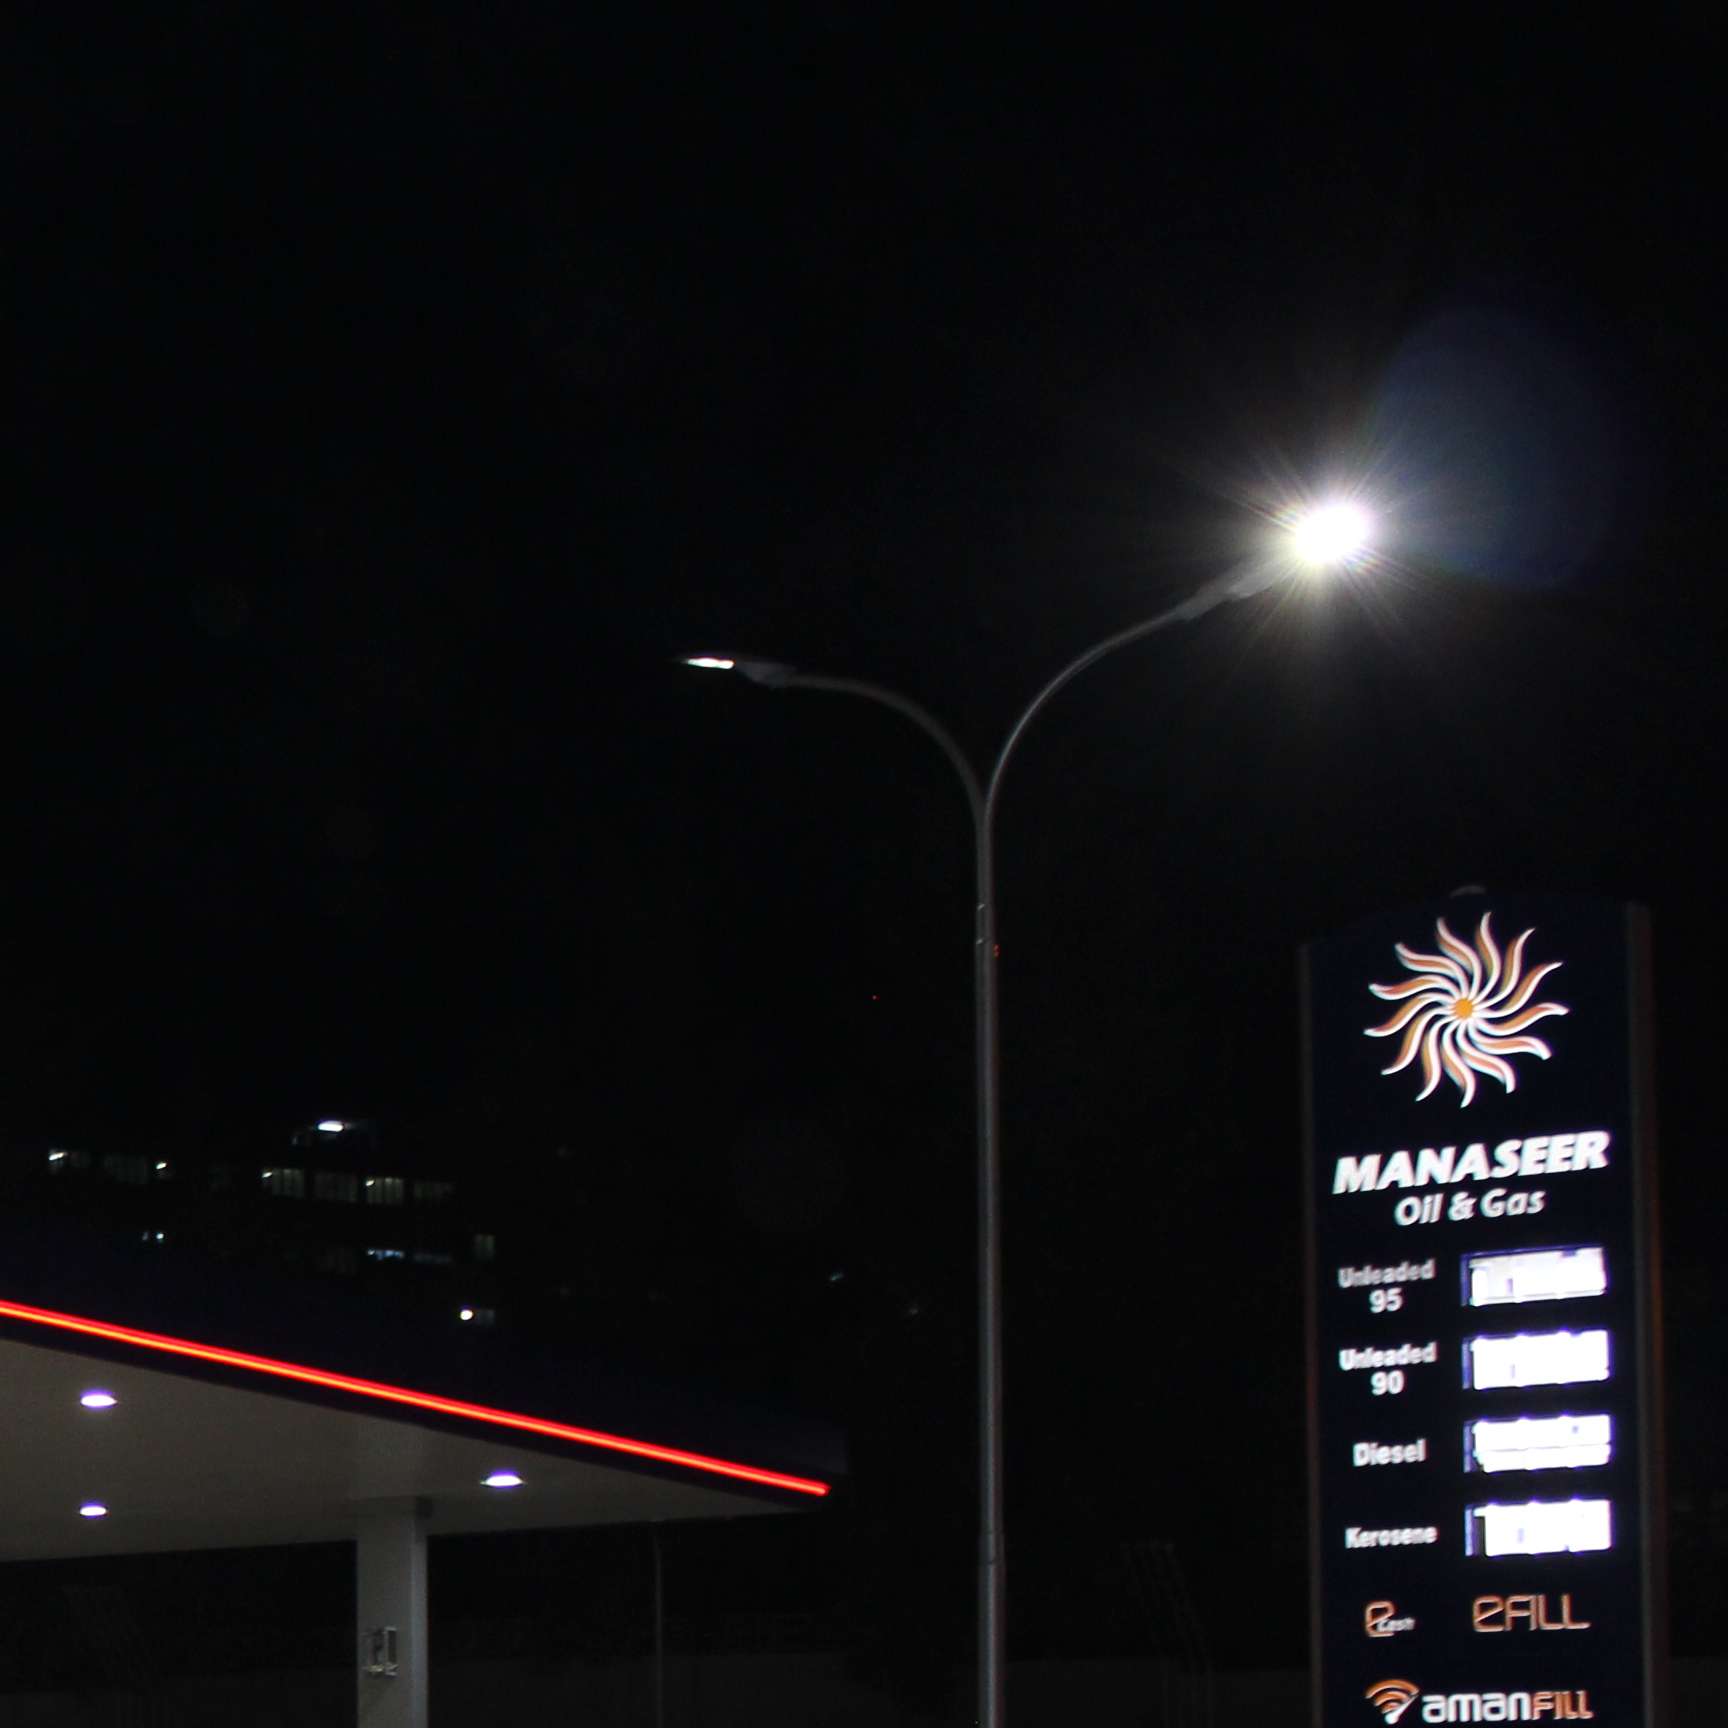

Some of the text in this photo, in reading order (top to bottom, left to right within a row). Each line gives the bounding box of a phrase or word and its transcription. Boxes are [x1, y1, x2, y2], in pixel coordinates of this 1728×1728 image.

[1333, 1131, 1610, 1194] MANASEER
[1395, 1188, 1545, 1225] Oil & Gas
[1338, 1259, 1435, 1288] Unleaded
[1370, 1288, 1403, 1313] 95
[1339, 1342, 1437, 1370] Unleaded
[1371, 1370, 1404, 1395] 90
[1353, 1439, 1426, 1466] Diesel
[1345, 1527, 1437, 1548] Kerosene
